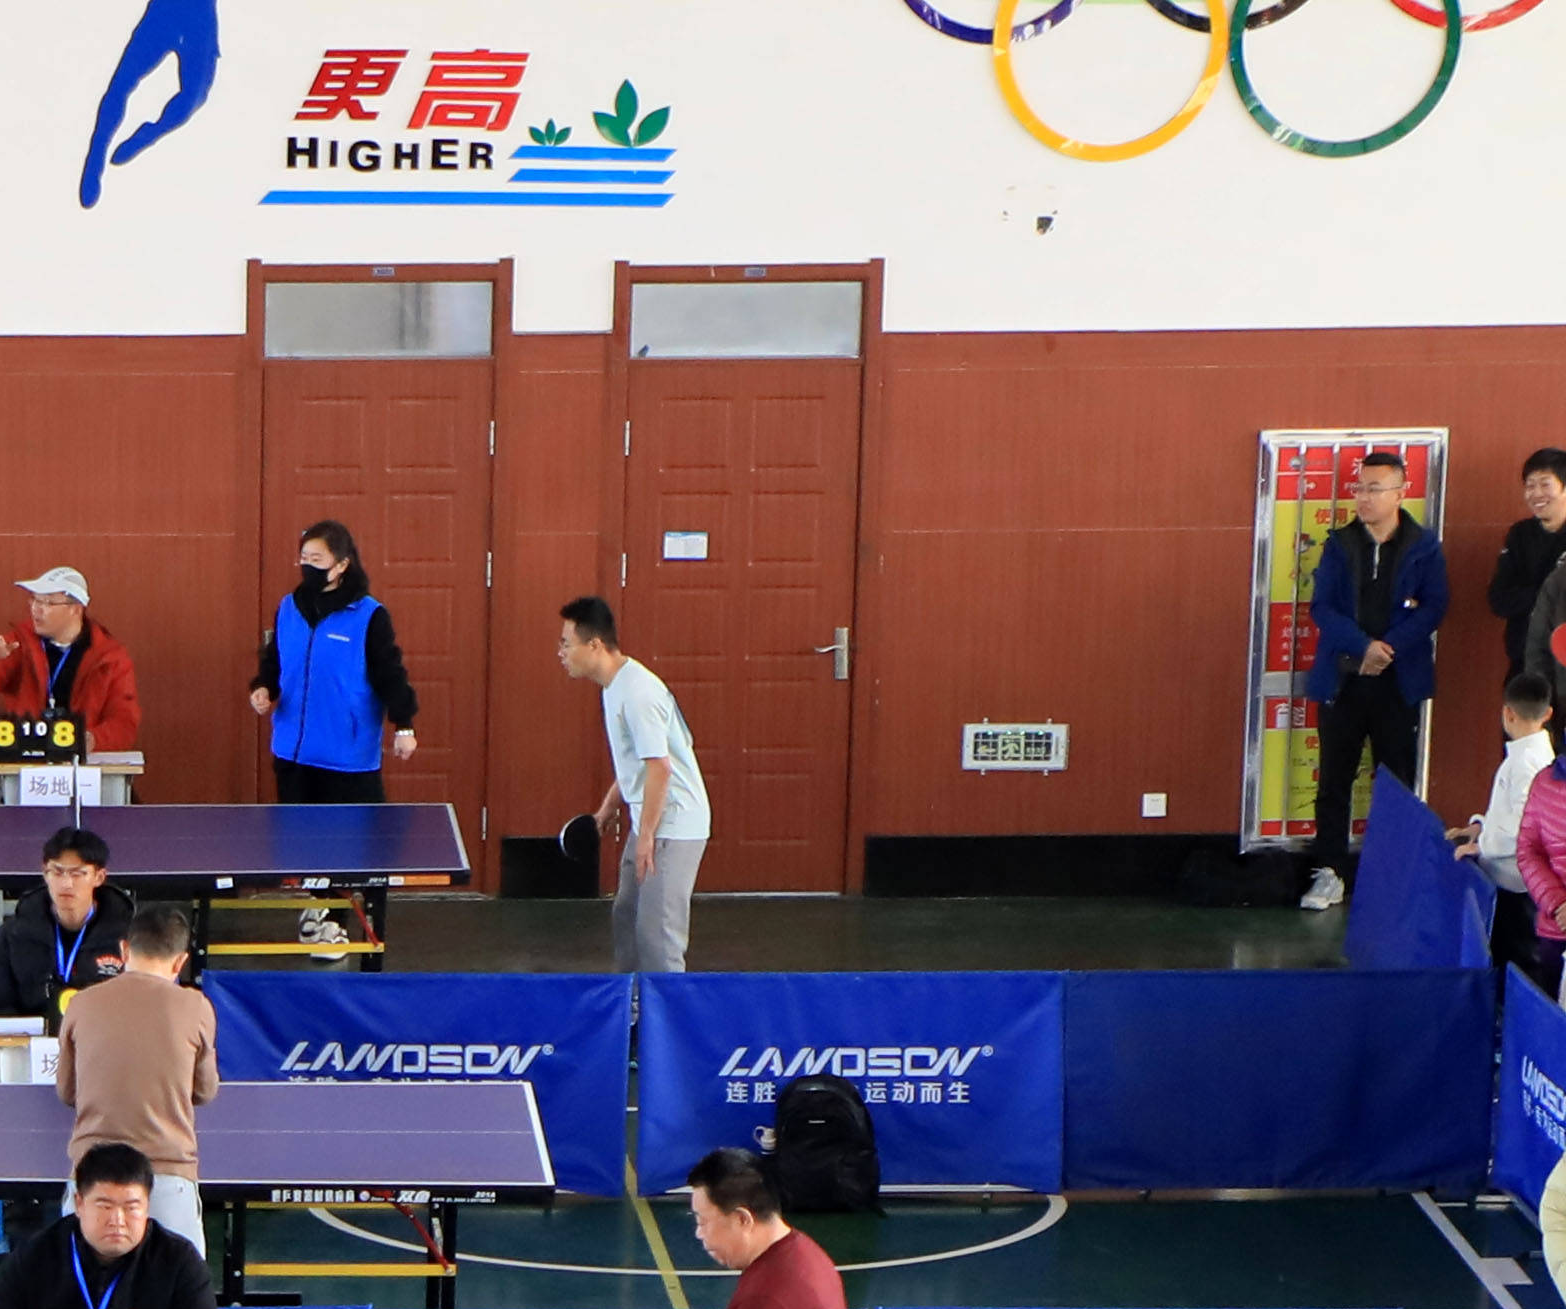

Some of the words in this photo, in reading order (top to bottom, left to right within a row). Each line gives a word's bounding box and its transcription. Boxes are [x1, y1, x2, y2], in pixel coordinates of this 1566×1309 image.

[294, 49, 529, 131] 更高
[286, 136, 493, 173] HIGHER
[52, 720, 76, 747] 8
